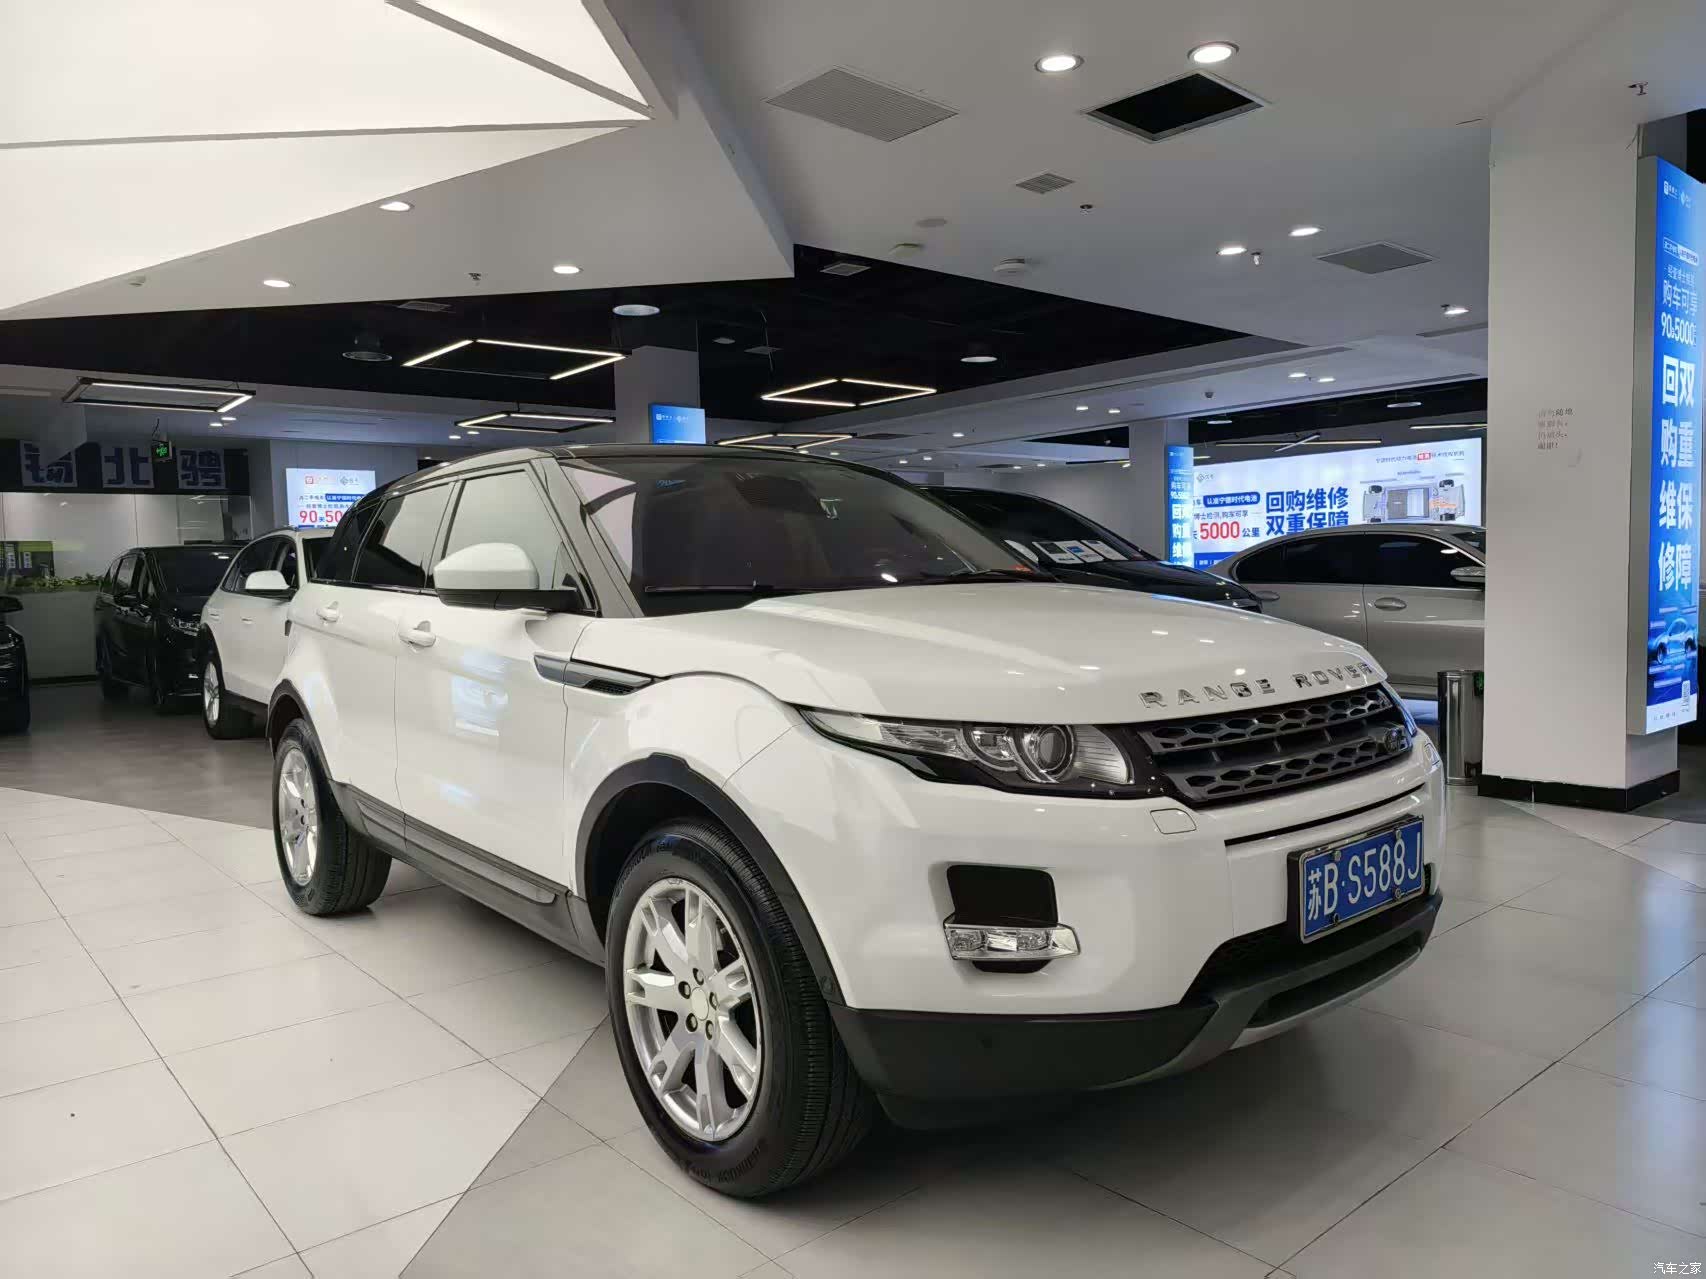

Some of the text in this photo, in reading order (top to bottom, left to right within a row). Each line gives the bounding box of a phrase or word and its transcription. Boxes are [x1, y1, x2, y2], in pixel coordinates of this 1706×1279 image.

[1266, 487, 1348, 513] 回购维修
[1266, 510, 1348, 536] 双重保障
[1139, 662, 1373, 709] RANGE ROVER
